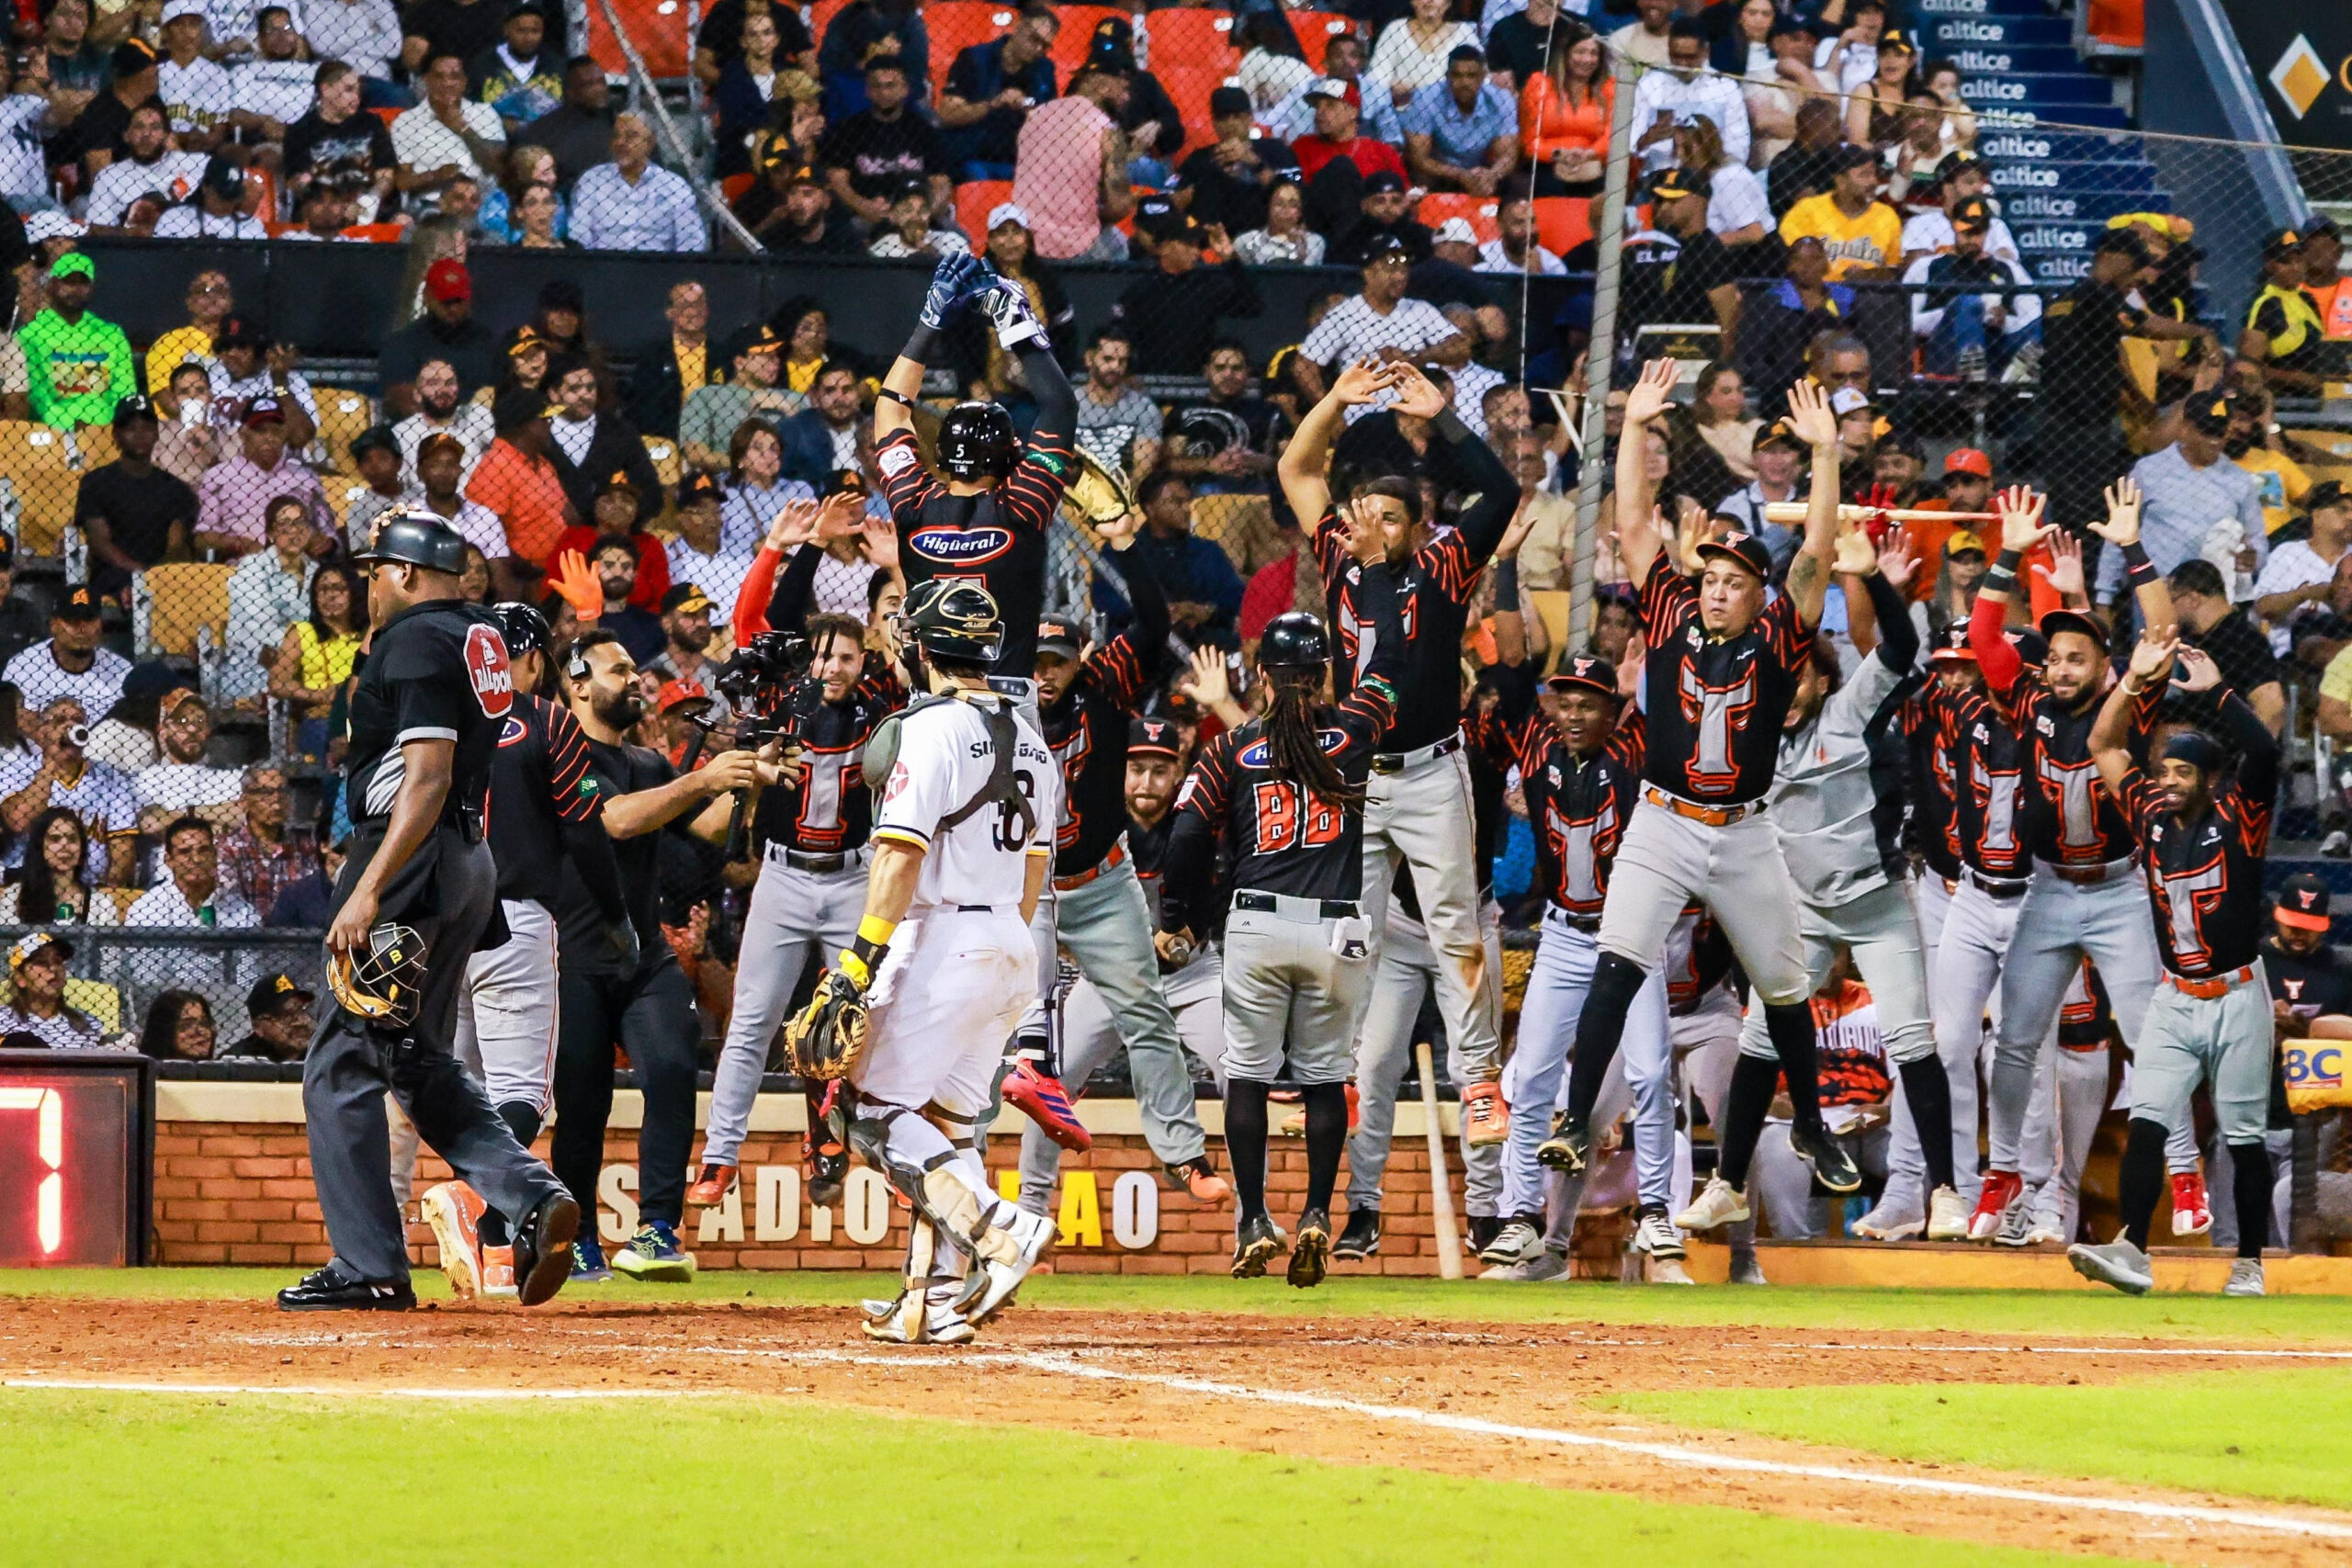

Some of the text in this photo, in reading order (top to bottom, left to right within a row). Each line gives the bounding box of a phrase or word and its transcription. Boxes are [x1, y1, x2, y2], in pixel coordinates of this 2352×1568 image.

[1939, 20, 2004, 41] altice
[1960, 79, 2027, 100] altice
[1984, 136, 2051, 157] altice
[1991, 165, 2059, 186] altice
[2009, 195, 2076, 216] altice
[2018, 227, 2087, 248] altice
[2039, 257, 2093, 276] altic
[956, 444, 965, 458] 5
